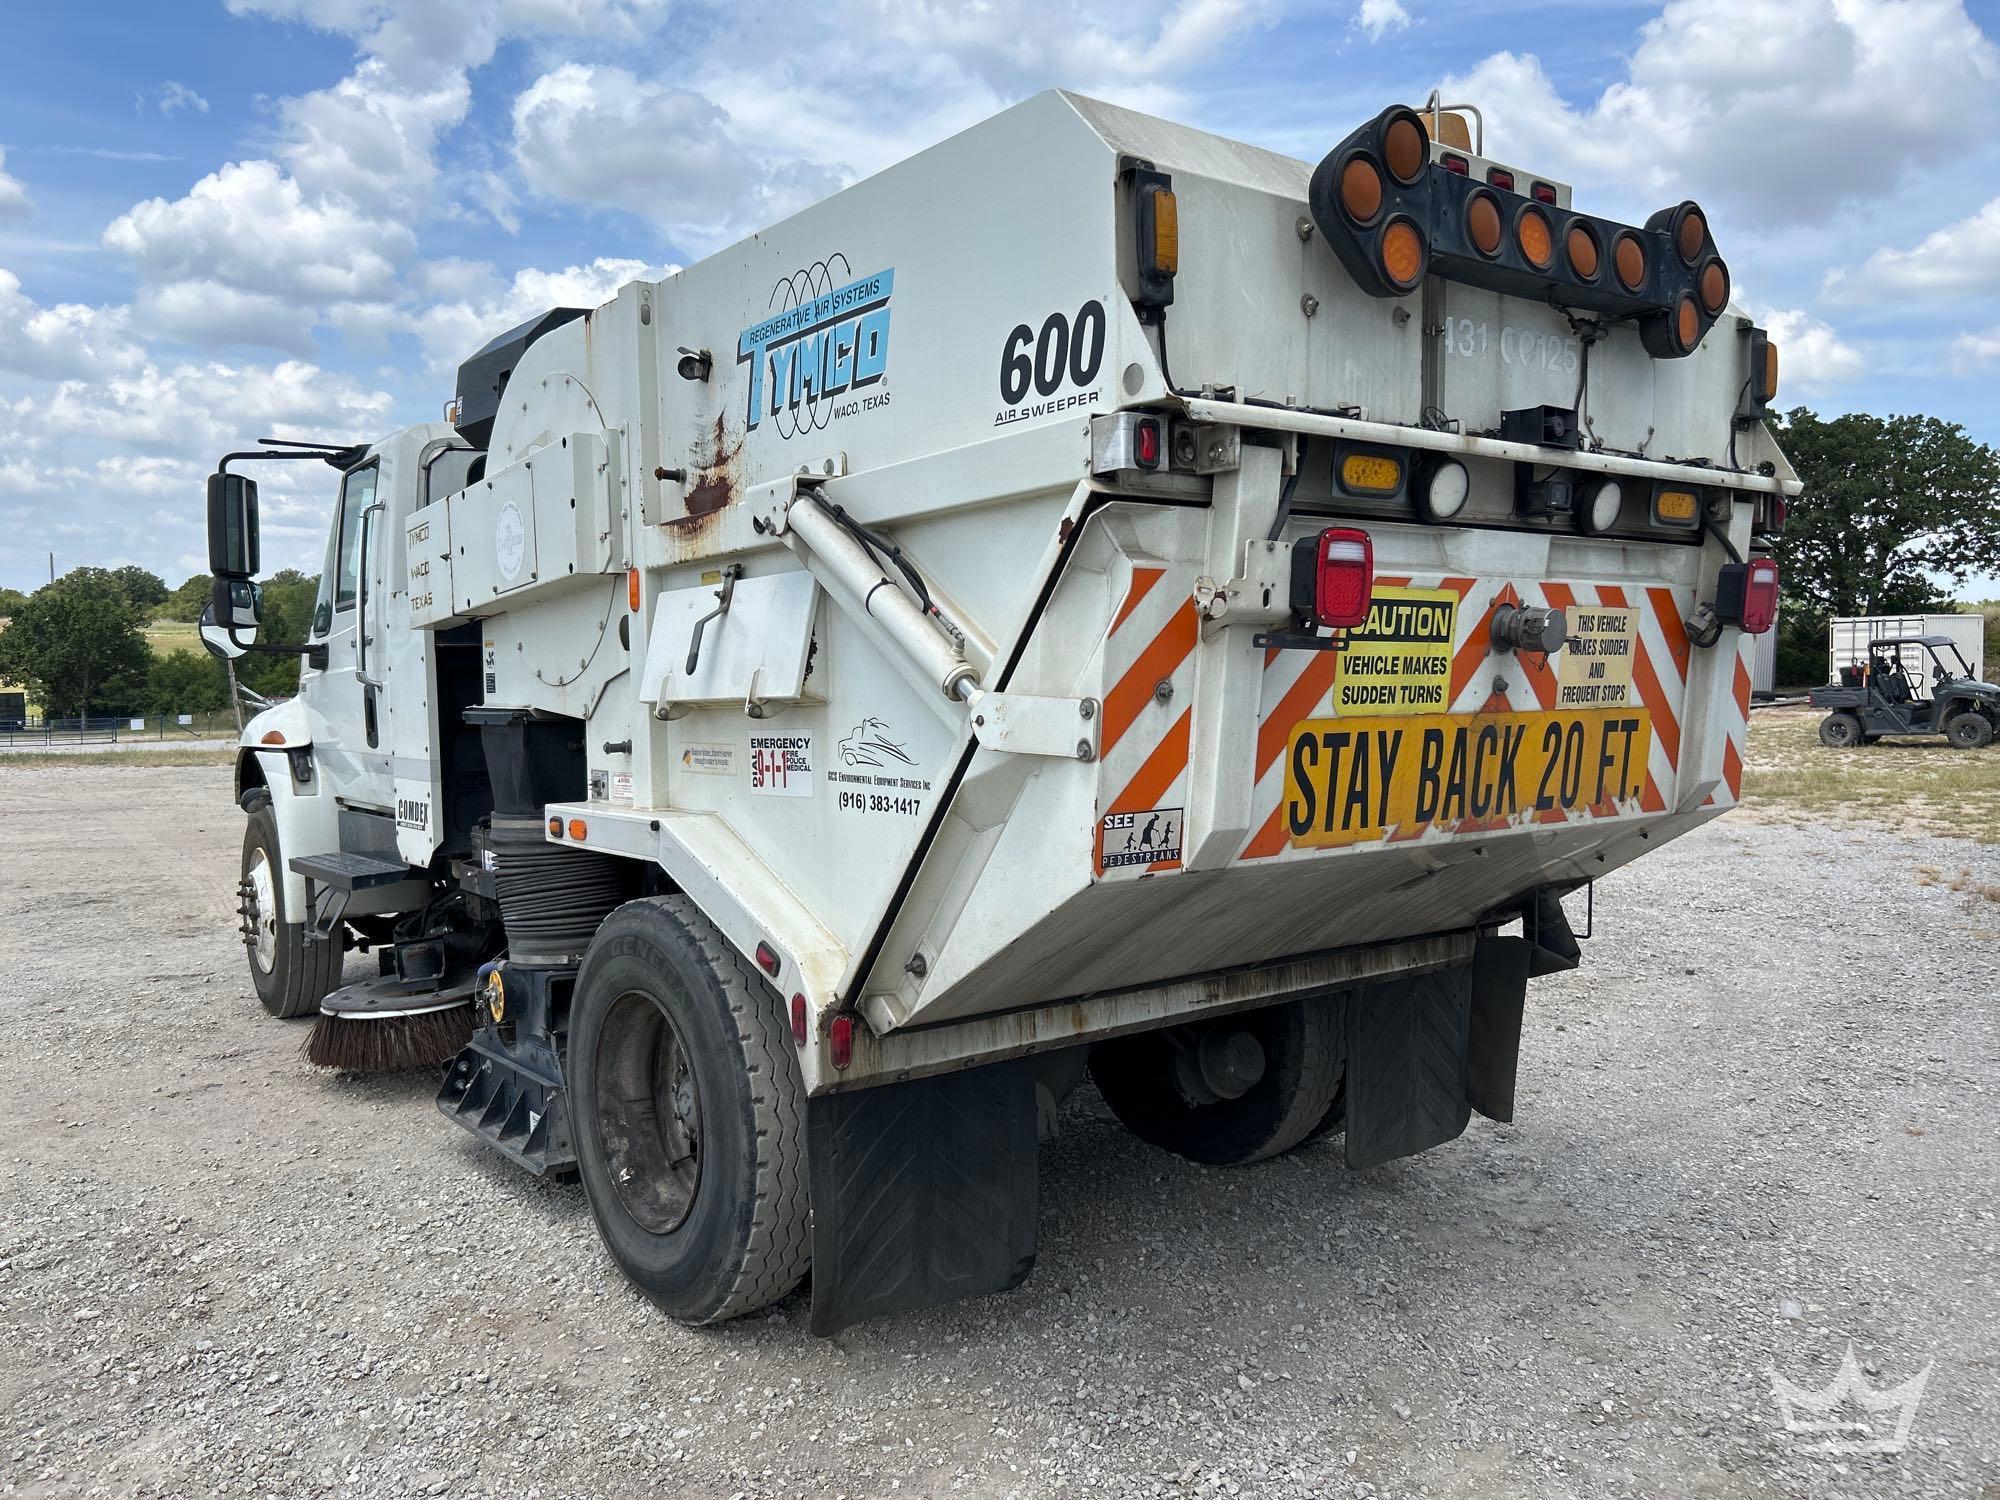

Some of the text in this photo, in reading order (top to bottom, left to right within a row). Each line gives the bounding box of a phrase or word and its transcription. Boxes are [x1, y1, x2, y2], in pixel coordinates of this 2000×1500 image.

[749, 279, 881, 346] REGENERATIVE AIR SYSTEMS
[737, 272, 893, 433] TYMCO
[1000, 299, 1106, 406] 600
[833, 392, 891, 421] WACO, TEXAS
[994, 391, 1099, 425] AIR SWEEPER
[410, 591, 433, 611] TEXAS
[1351, 605, 1450, 637] AUTION
[1578, 614, 1628, 633] THIS VEHICLE
[1569, 638, 1629, 656] AKES SUDDEN
[1343, 655, 1448, 675] VEHICLE MAKES
[1588, 661, 1606, 679] AND
[1341, 685, 1442, 705] SUDDEN TURNS
[1562, 684, 1626, 704] FREQUENT STOPS
[750, 737, 811, 750] EMERGENCY
[786, 750, 799, 758] FIRE
[786, 757, 807, 765] POLICE
[751, 750, 759, 788] DIAL
[757, 748, 787, 789] 9-1-1
[786, 764, 812, 772] MEDICAL
[1289, 719, 1640, 837] STAY BACK 20 FT.
[398, 798, 429, 825] COMDEX
[838, 791, 921, 816] (916) 383-1417
[1103, 813, 1134, 830] SEE
[1102, 849, 1179, 867] PEDESTRIANS
